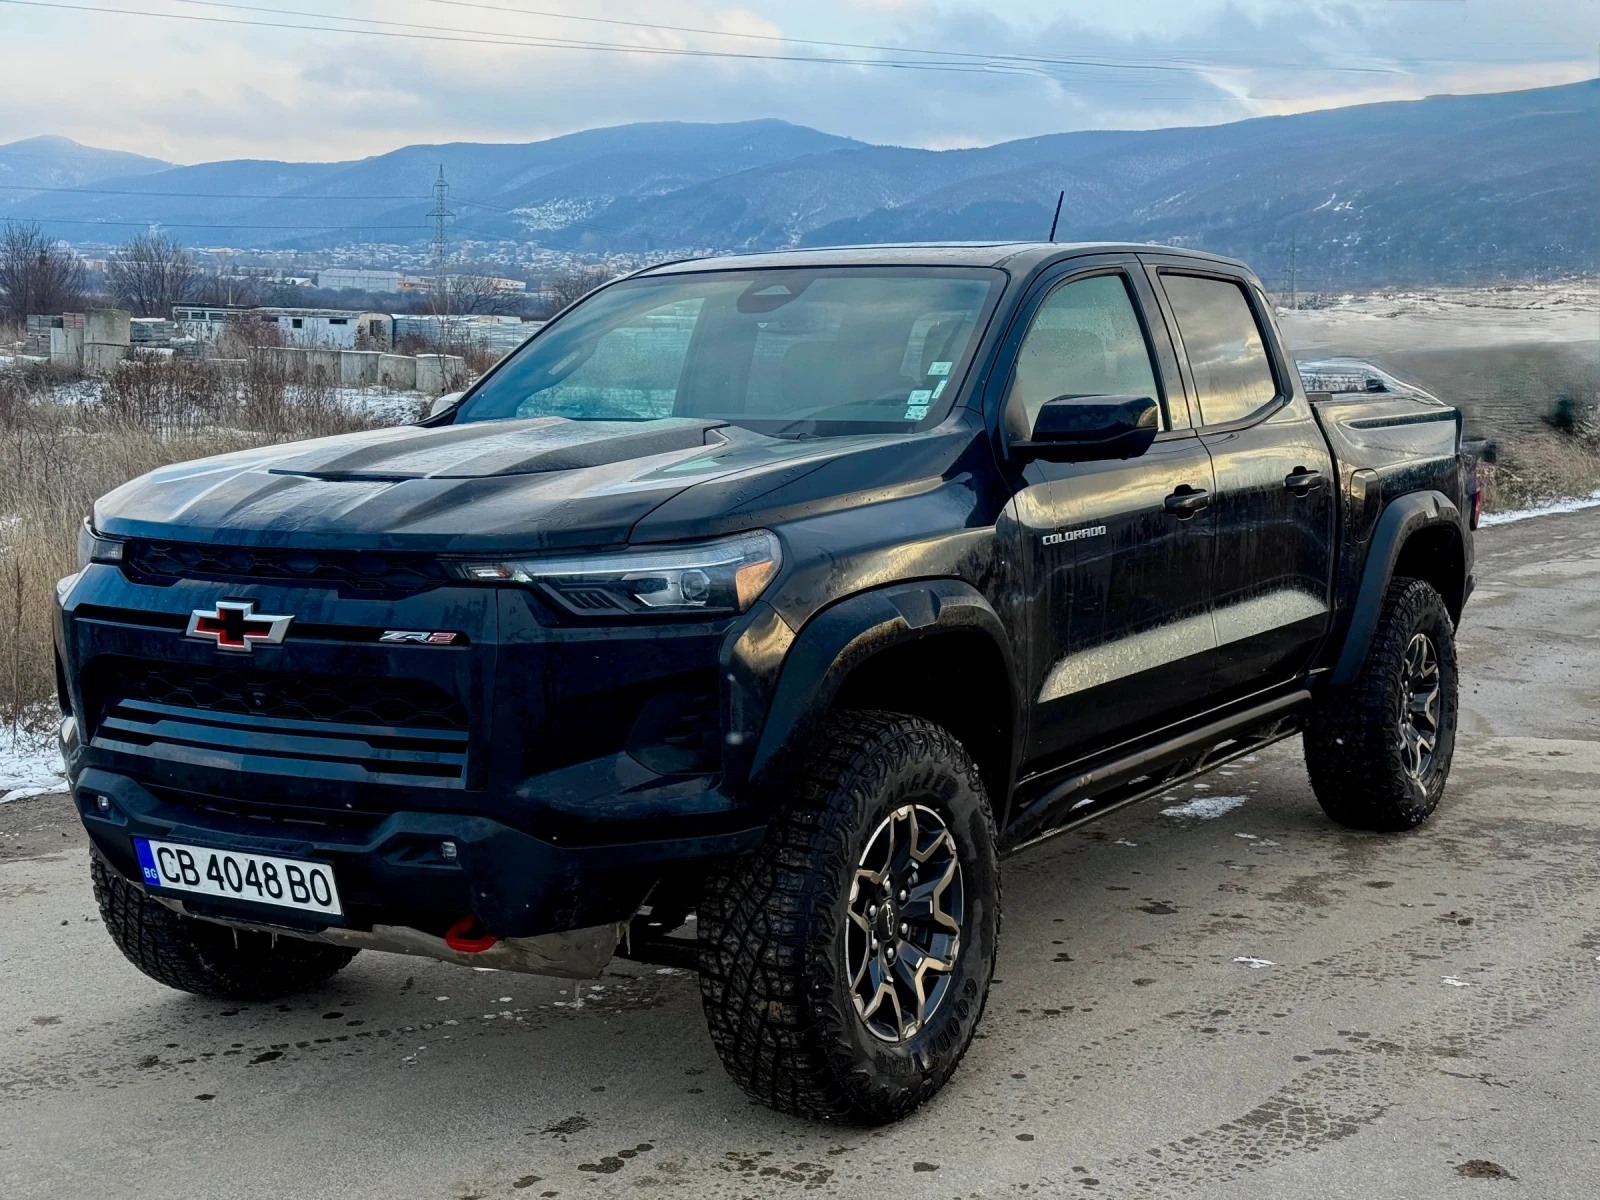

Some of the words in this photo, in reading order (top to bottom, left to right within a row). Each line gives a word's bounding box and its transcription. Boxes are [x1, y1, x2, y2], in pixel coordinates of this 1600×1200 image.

[1042, 525, 1107, 546] COLORADO
[379, 630, 457, 645] ZR2
[143, 867, 158, 879] BG
[156, 846, 201, 886] CB
[206, 853, 283, 899] 4048
